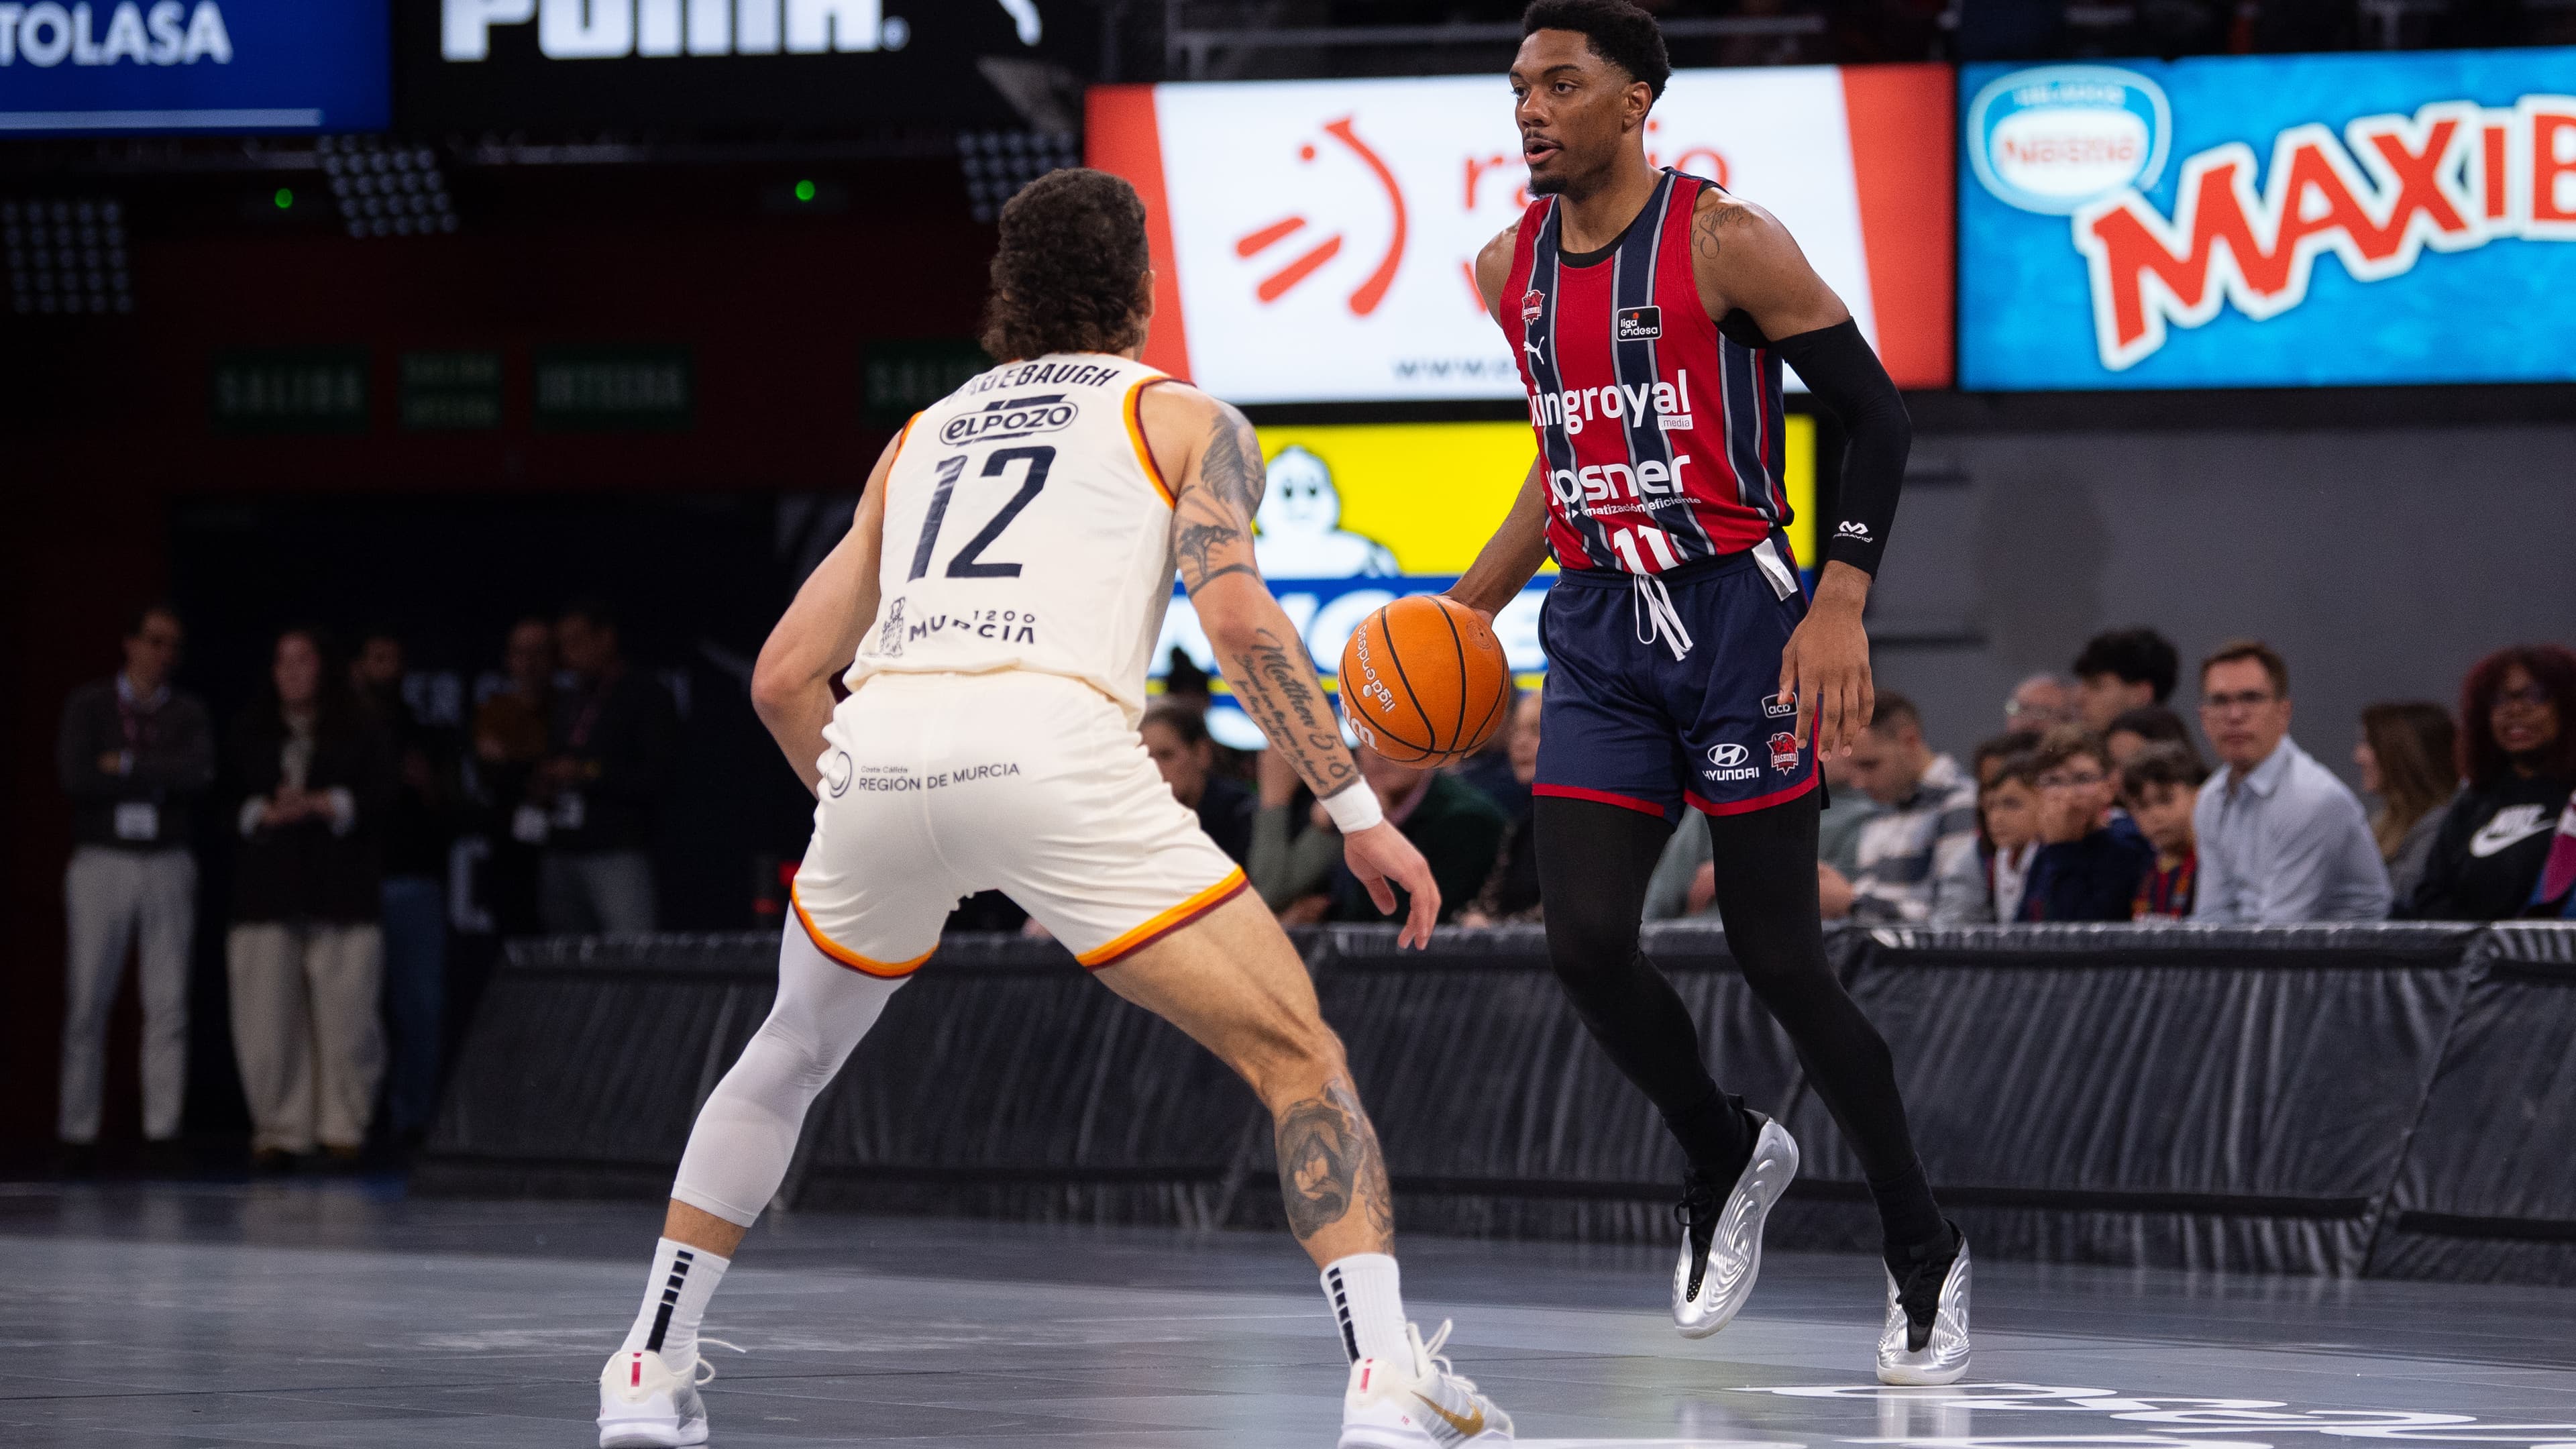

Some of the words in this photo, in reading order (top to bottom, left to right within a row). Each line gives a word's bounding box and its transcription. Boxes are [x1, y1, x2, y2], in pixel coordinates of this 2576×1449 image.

[1621, 318, 1638, 329] liga
[1621, 326, 1658, 336] endesa
[945, 364, 1120, 407] DEBAUGH
[906, 445, 1056, 583] 12
[1581, 502, 1646, 517] matización
[1648, 497, 1702, 511] eficiente
[1613, 525, 1681, 576] 11
[973, 609, 1036, 624] 1200
[1768, 703, 1790, 715] acb
[859, 775, 921, 792] REGIÓN
[927, 774, 948, 789] DE
[953, 763, 1020, 783] MURCIA
